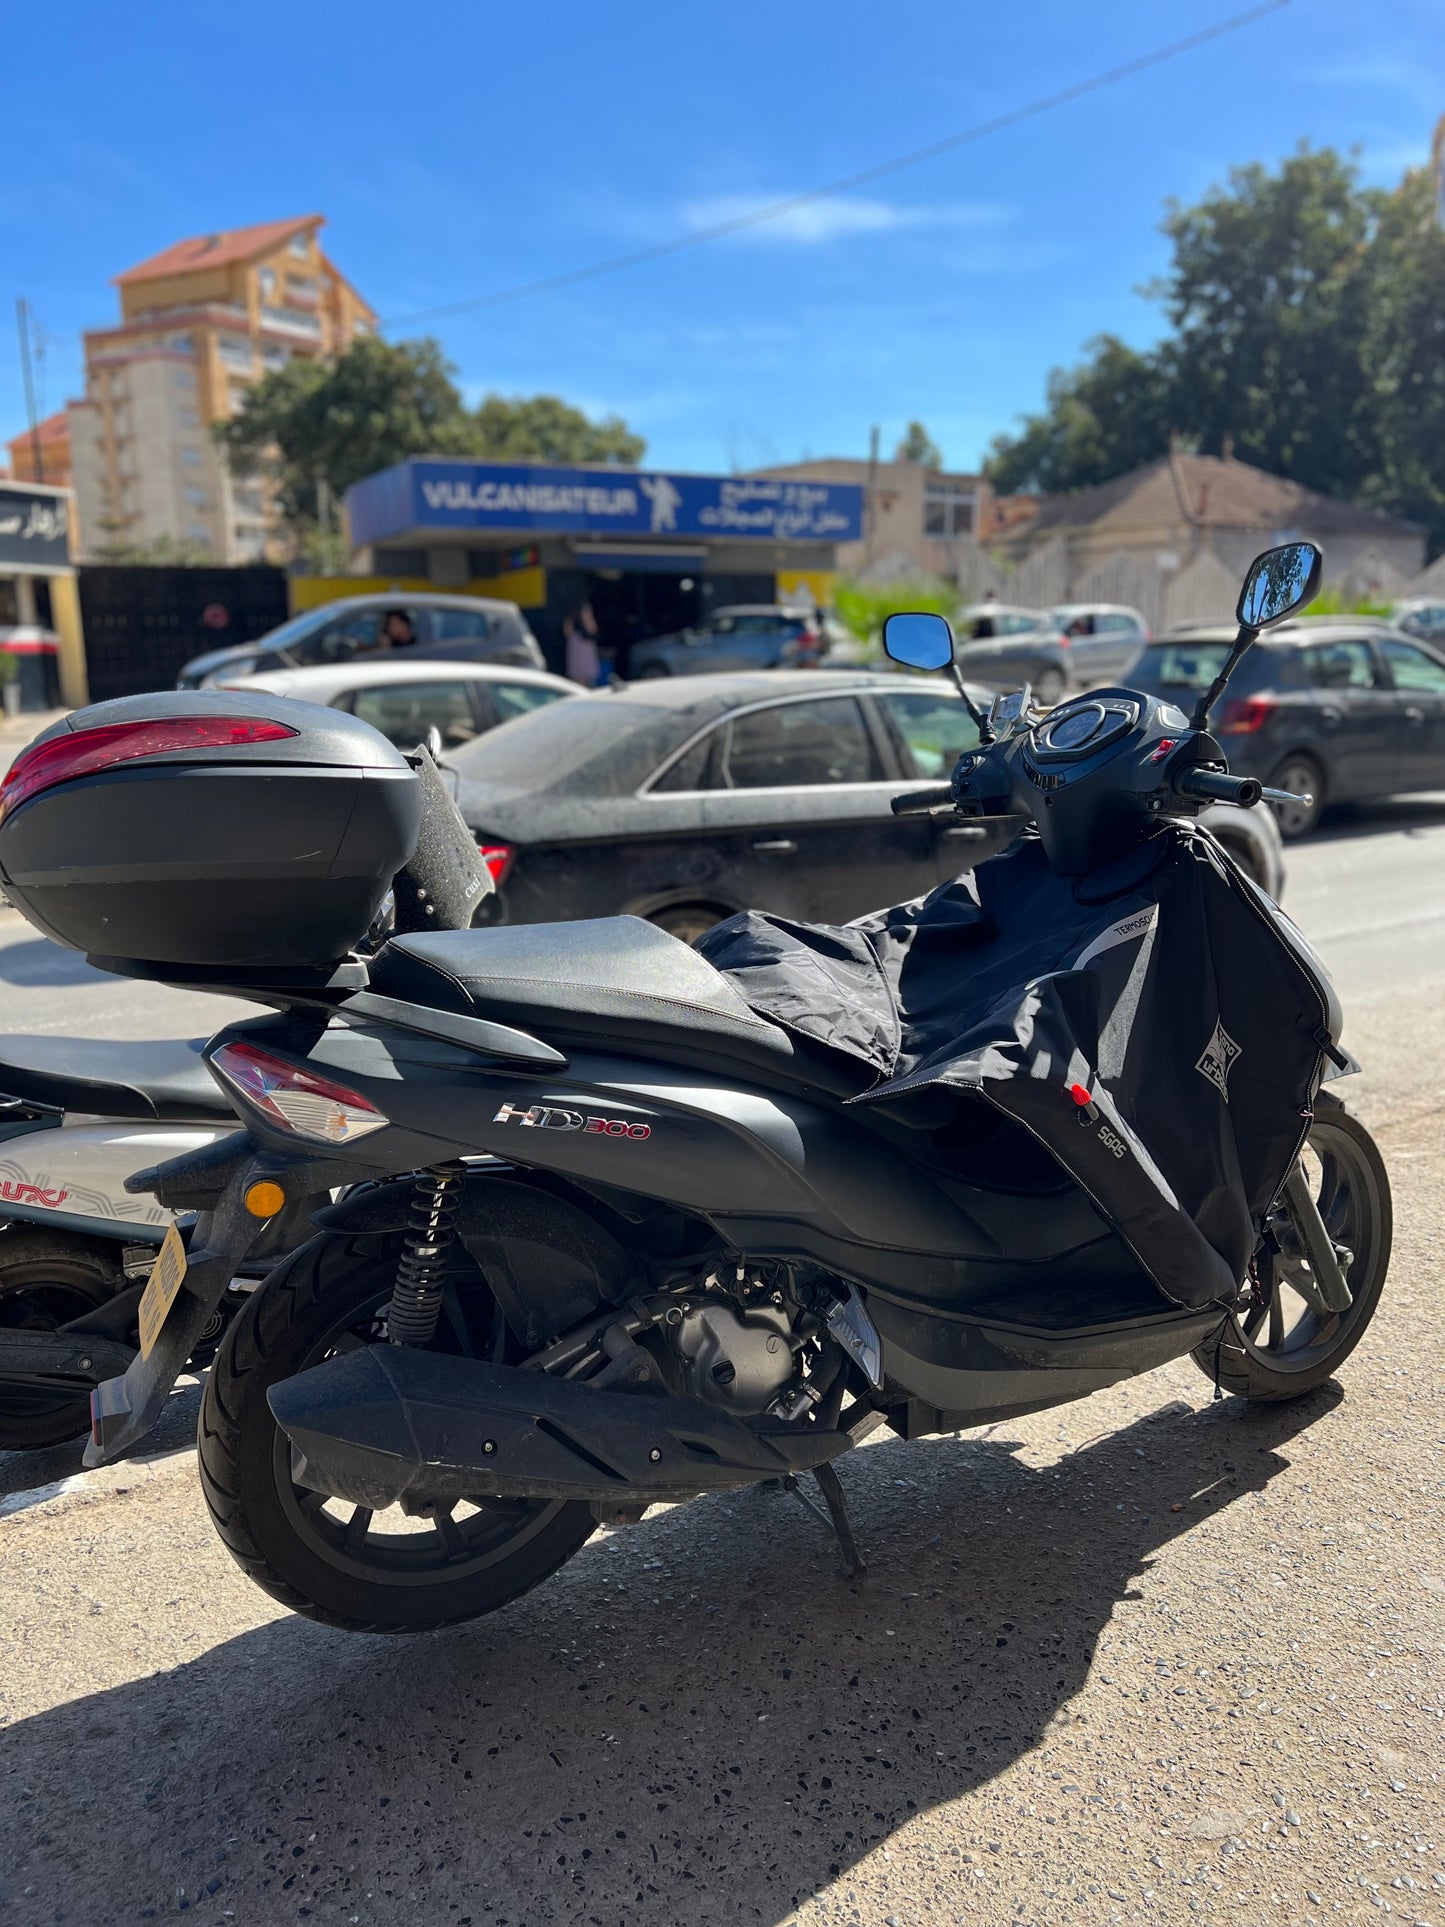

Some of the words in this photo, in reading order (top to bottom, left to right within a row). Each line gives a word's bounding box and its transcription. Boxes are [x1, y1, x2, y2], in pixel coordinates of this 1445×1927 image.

[492, 1101, 583, 1131] HD
[582, 1115, 652, 1141] 300
[1097, 1125, 1128, 1158] SGAS
